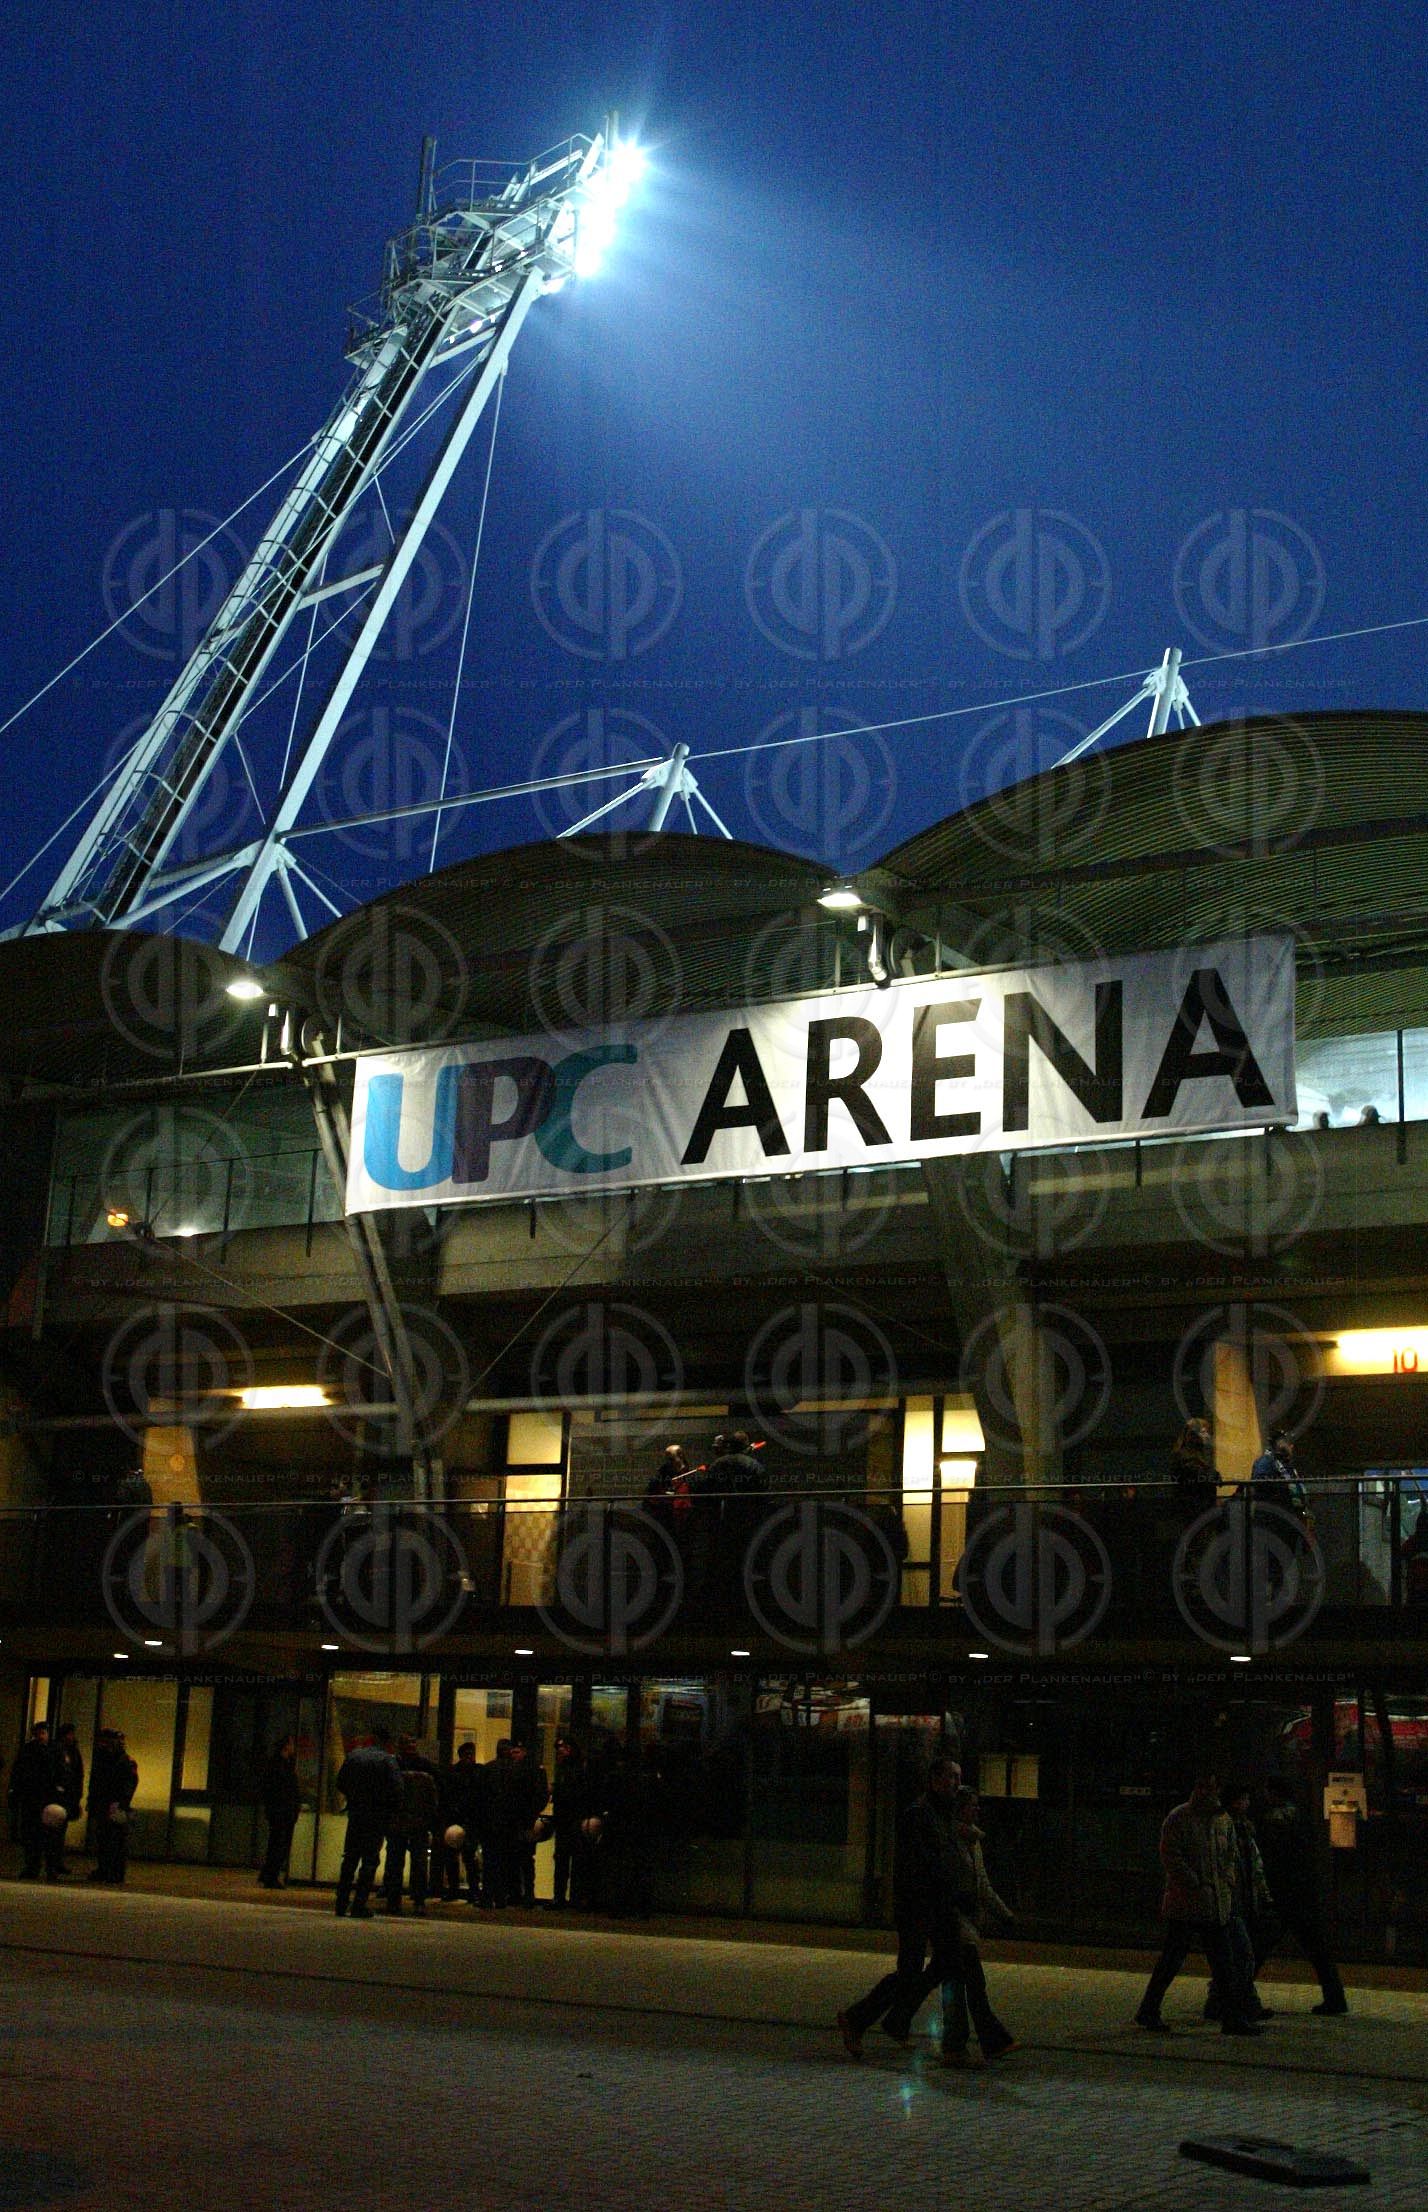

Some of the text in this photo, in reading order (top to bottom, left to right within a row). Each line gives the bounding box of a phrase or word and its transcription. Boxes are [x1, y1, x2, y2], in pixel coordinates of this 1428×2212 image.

[364, 968, 1275, 1191] UPC ARENA
[1393, 1346, 1418, 1373] 10
